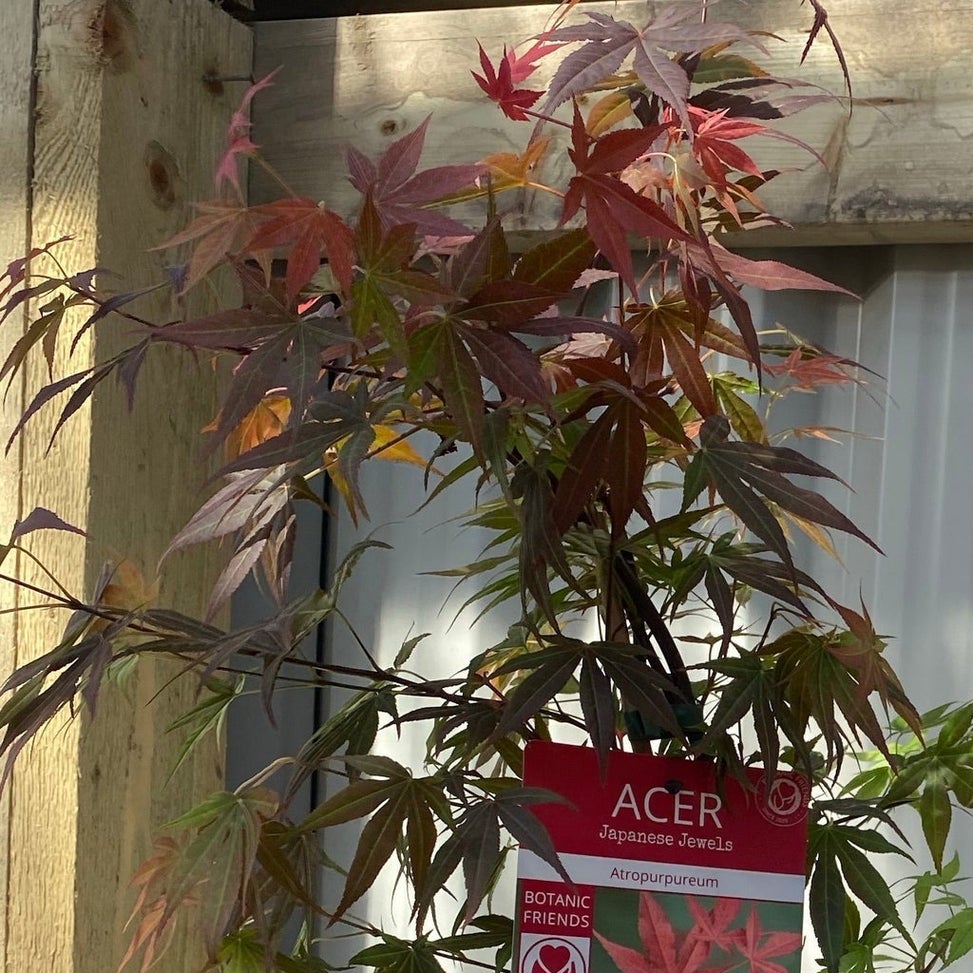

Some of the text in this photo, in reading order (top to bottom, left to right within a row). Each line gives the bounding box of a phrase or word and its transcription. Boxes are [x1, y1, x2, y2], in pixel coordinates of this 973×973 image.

[611, 783, 723, 829] ACER
[599, 824, 733, 852] Japanese Jewels
[610, 866, 719, 888] Atropurpureum
[525, 890, 591, 909] BOTANIC
[523, 910, 590, 928] FRIENDS
